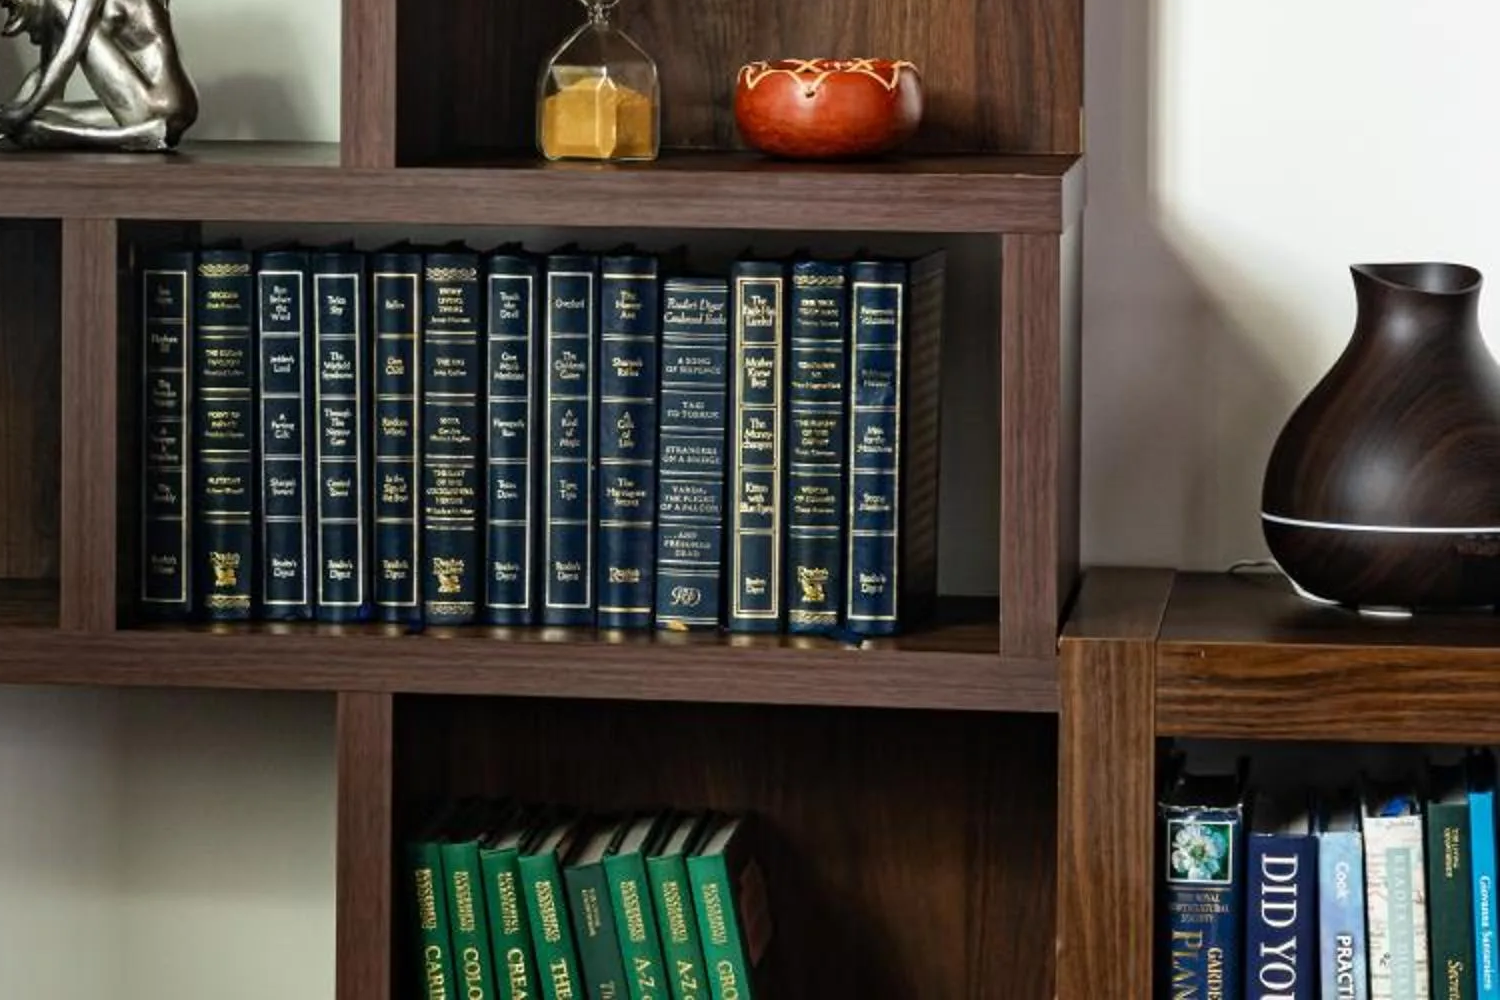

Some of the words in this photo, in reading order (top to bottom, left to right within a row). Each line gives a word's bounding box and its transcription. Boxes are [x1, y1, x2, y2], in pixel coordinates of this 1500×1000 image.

[1260, 853, 1299, 929] DID
[1334, 861, 1352, 904] Cook
[1259, 935, 1298, 1000] YO
